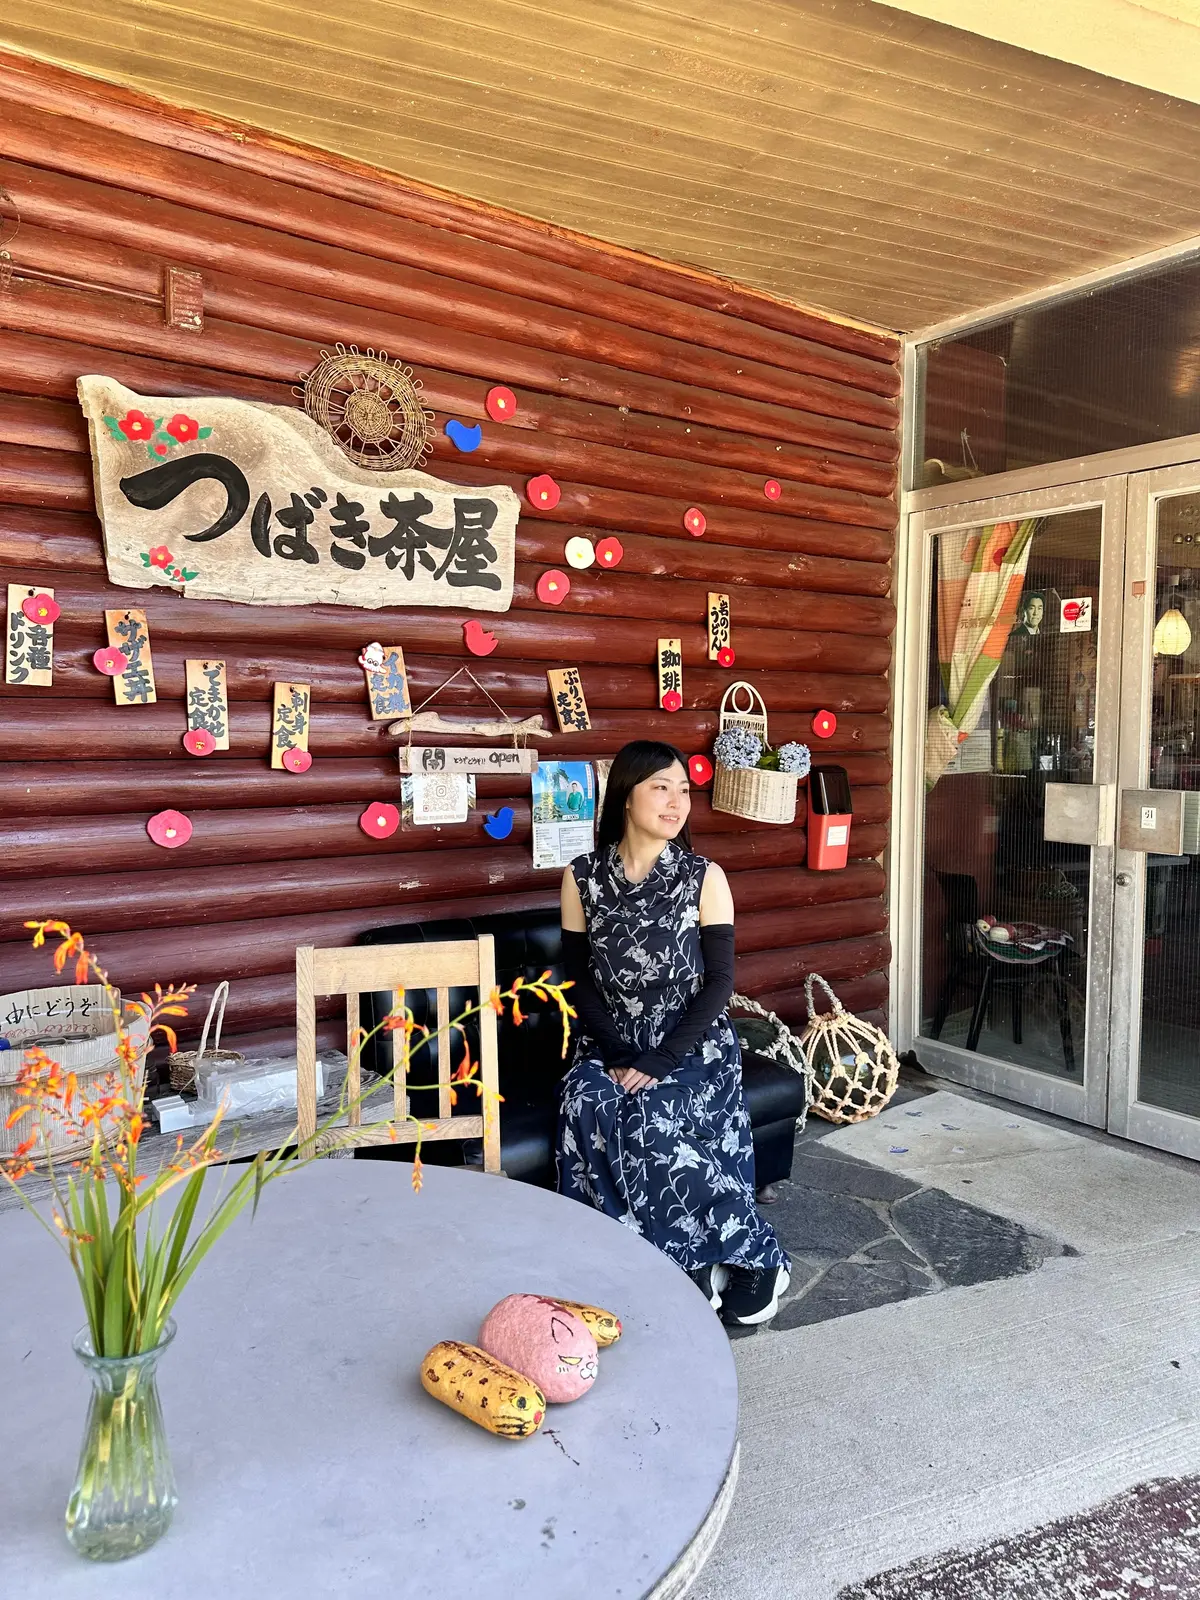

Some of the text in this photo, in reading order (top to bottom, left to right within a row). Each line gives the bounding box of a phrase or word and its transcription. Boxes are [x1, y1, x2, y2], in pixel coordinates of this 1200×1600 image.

[119, 453, 502, 591] つばき茶屋
[711, 606, 722, 651] うどん
[719, 600, 729, 642] 岩のり
[9, 610, 29, 683] ドリンク
[114, 619, 154, 702] サザエ丼
[661, 649, 681, 693] 珈琲
[188, 686, 209, 731] 定食
[202, 662, 226, 738] でまかせ
[290, 691, 309, 735] 刺身
[371, 673, 392, 715] 定食
[556, 691, 576, 726] 定食
[273, 703, 298, 749] 定食
[0, 997, 98, 1030] 由にどうぞ
